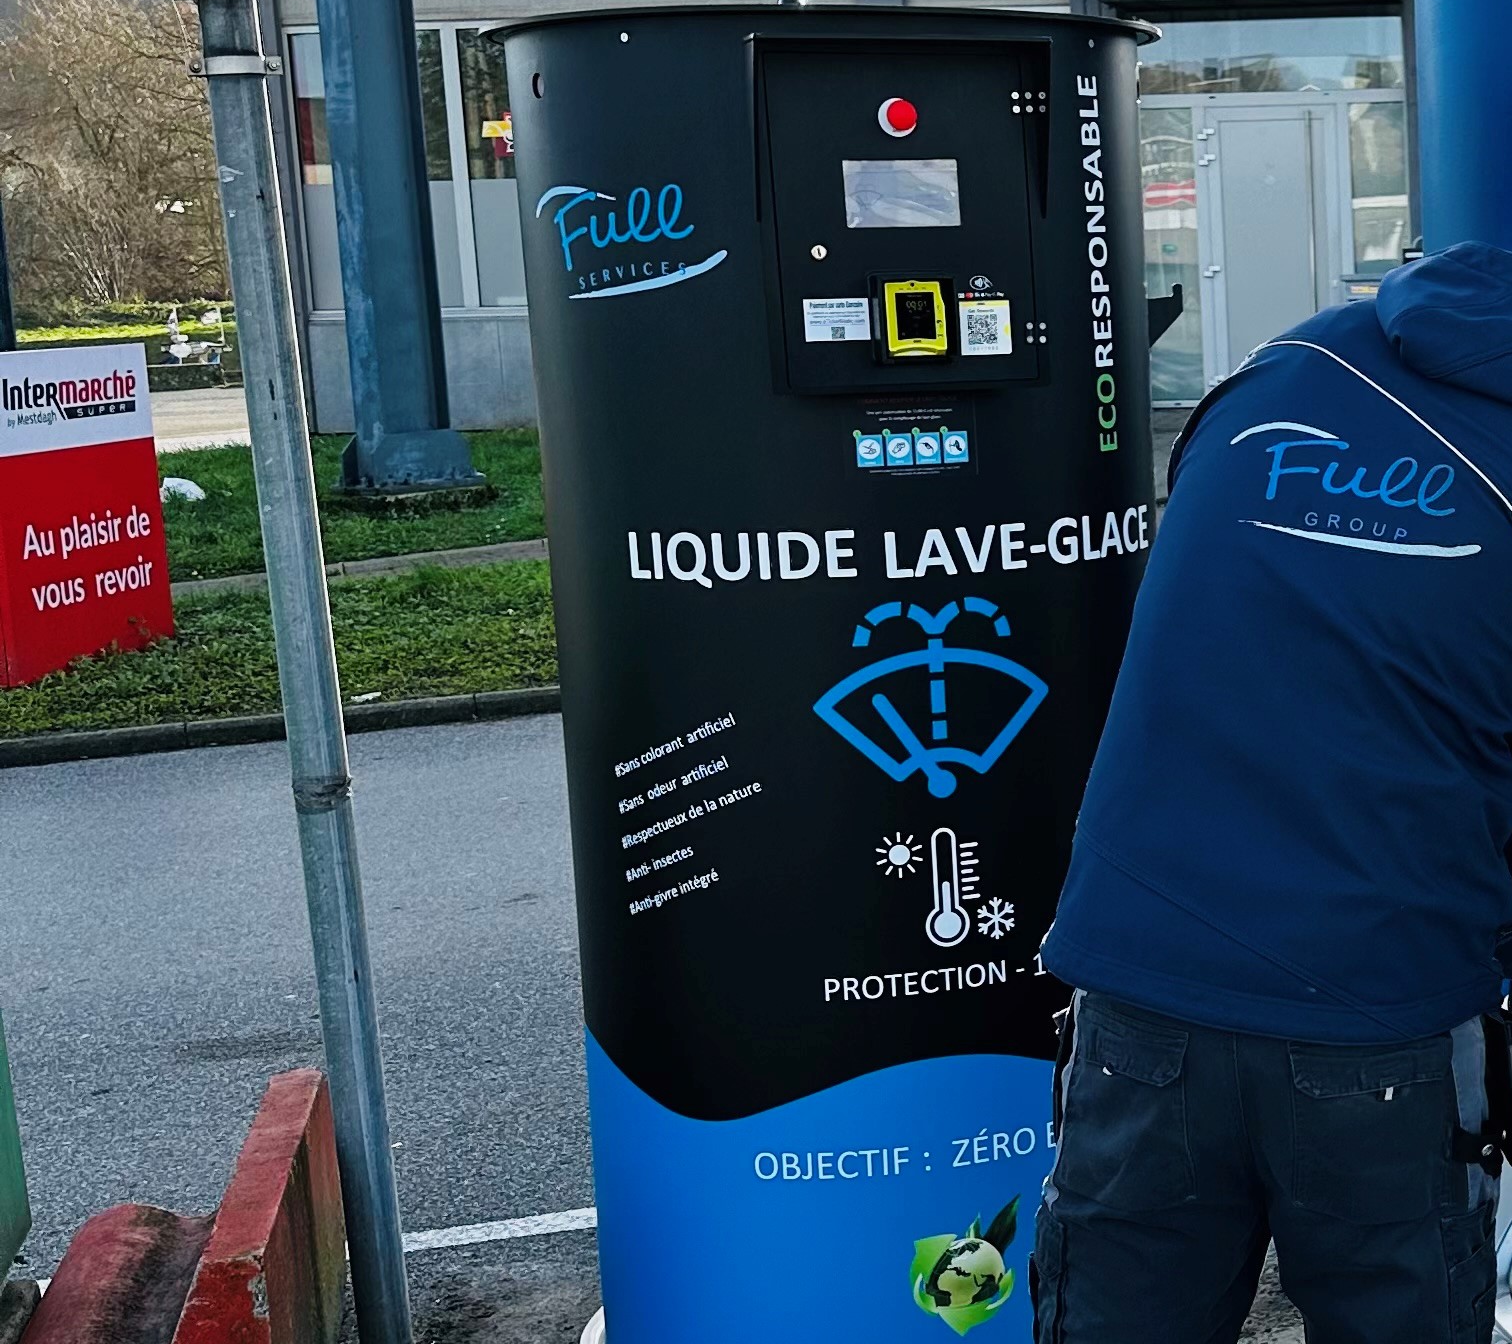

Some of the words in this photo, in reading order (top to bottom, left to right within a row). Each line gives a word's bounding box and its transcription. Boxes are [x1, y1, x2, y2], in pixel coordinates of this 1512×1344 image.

[554, 183, 694, 271] Full
[578, 261, 687, 290] SERVICES
[1077, 74, 1118, 452] ECORESPONSABLE
[2, 369, 136, 420] Intermarché
[7, 417, 16, 429] by
[17, 410, 57, 426] Mestdagh
[1265, 439, 1455, 517] Full
[23, 524, 55, 559] Au
[60, 510, 121, 559] plaisir
[126, 505, 151, 539] de
[627, 529, 858, 588] LIQUIDE
[883, 503, 1148, 578] LAVE-GLACE
[1304, 511, 1408, 541] GROUP
[32, 576, 85, 611] vous
[95, 555, 153, 597] revoir
[614, 757, 641, 778] #Sans
[641, 736, 684, 765] colorant
[686, 711, 736, 744] artificiel
[618, 793, 644, 815] #Sans
[647, 778, 677, 800] odeur
[681, 755, 729, 786] artificiel
[621, 812, 688, 849] #Respectueux
[688, 804, 704, 820] de
[703, 799, 717, 812] la
[718, 781, 763, 806] nature
[652, 846, 694, 871] insectes
[629, 885, 679, 915] #Anti-givre
[678, 867, 719, 896] intégré
[823, 958, 1006, 1001] PROTECTION
[754, 1147, 909, 1181] OBJECTIF
[952, 1128, 1036, 1168] ZÉRO
